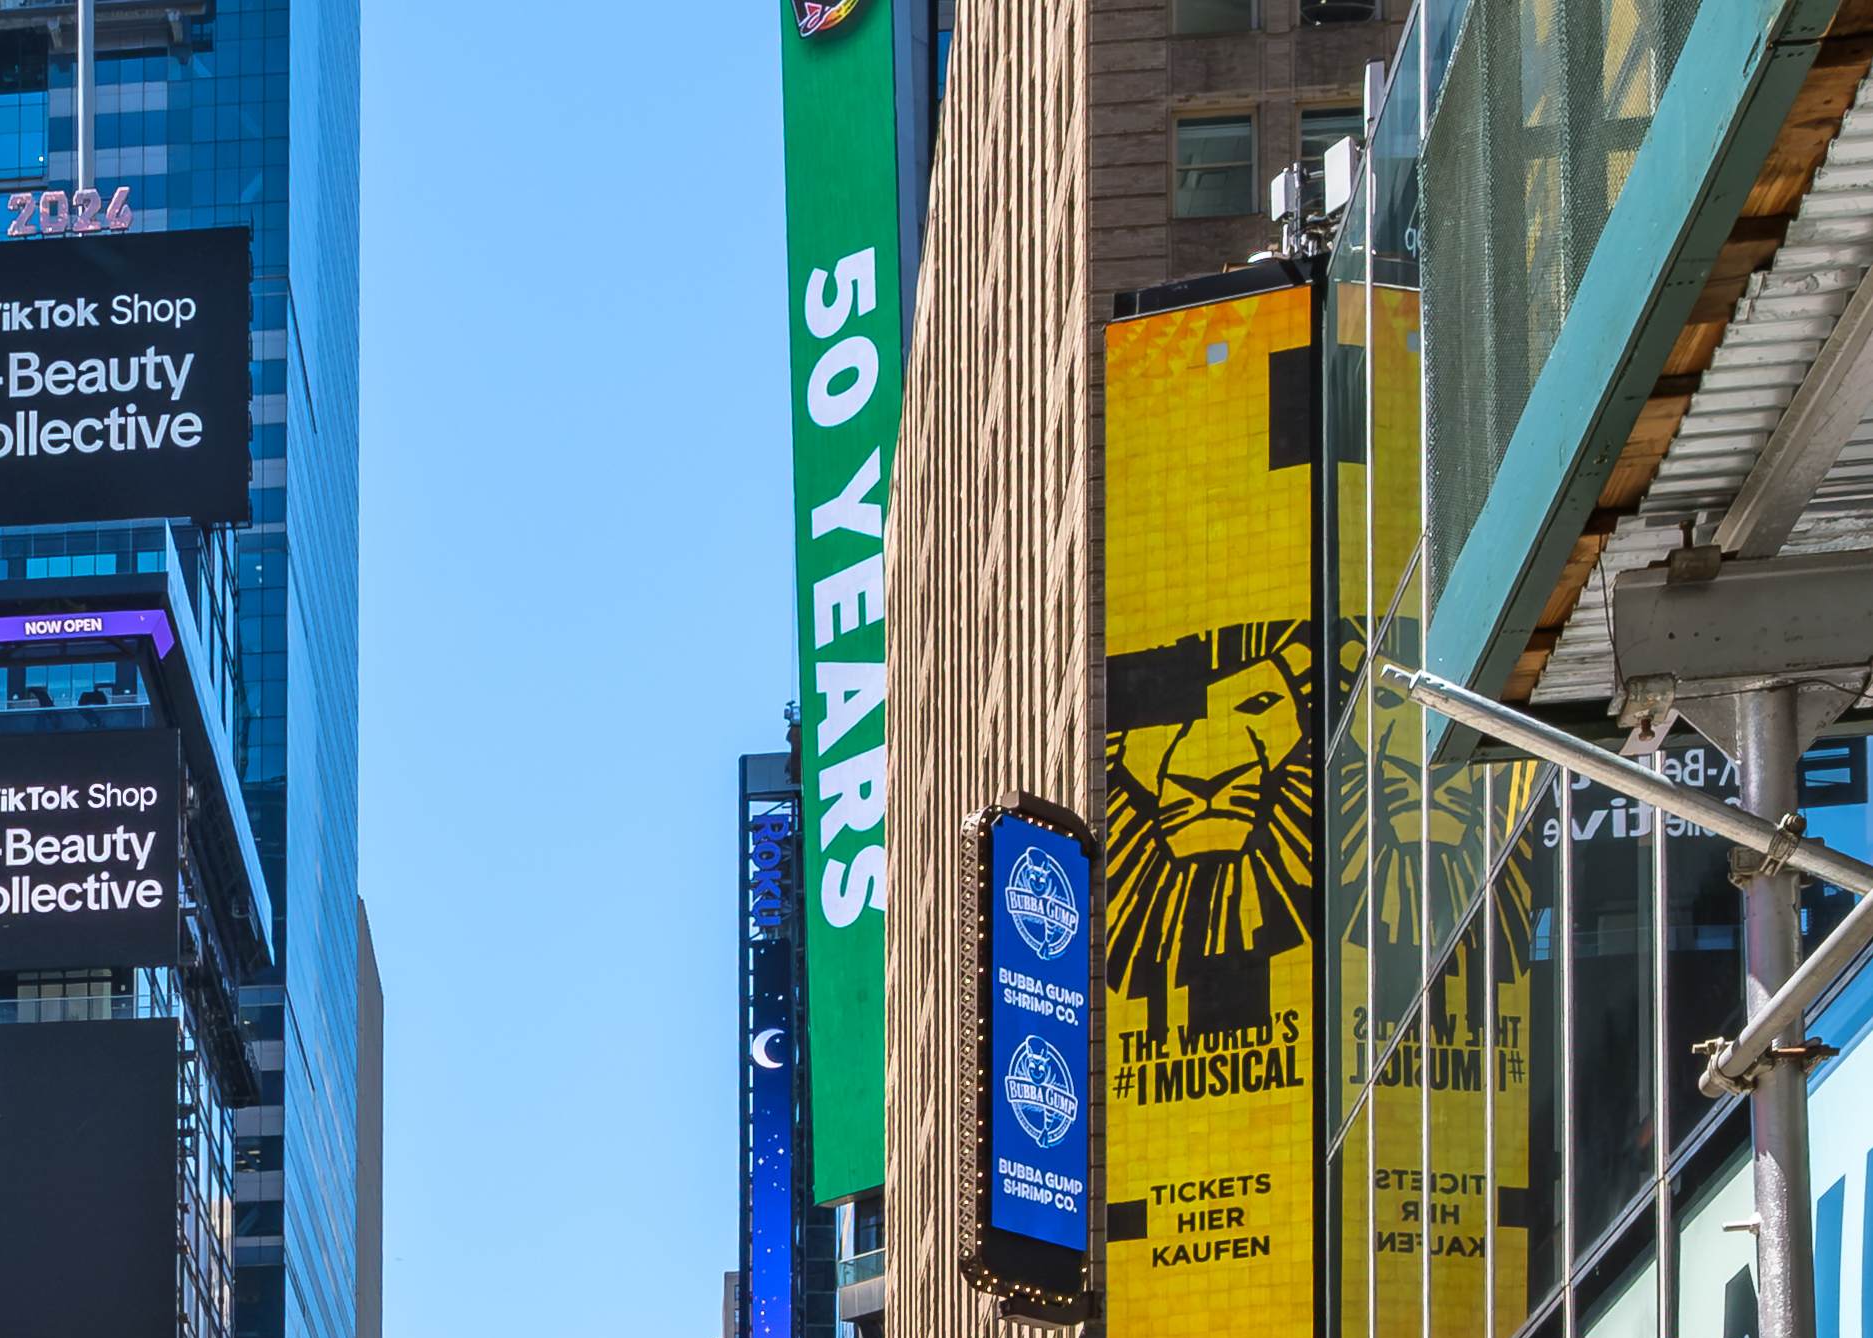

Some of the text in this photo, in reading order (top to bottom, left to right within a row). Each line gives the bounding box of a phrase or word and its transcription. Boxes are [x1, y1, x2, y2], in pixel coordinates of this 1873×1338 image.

[109, 294, 197, 332] Shop
[804, 247, 886, 928] 50 YEARS
[24, 617, 103, 636] NOW OPEN
[87, 782, 158, 813] Shop
[1009, 890, 1077, 928] BUBBA GUMP
[999, 967, 1084, 1008] BUBBA GUMP
[1004, 989, 1079, 1027] SHRIMP CO.
[1118, 1009, 1300, 1064] THE WORLD'S
[1113, 1045, 1304, 1106] #1 MUSICAL
[1009, 1079, 1077, 1117] BUBBA GUMP
[999, 1158, 1083, 1195] BUBBA GUMP
[1150, 1173, 1272, 1208] TICKETS
[1004, 1180, 1078, 1214] SHRIMP CO.
[1177, 1207, 1245, 1235] HIER
[1152, 1233, 1272, 1268] KAUFEN
